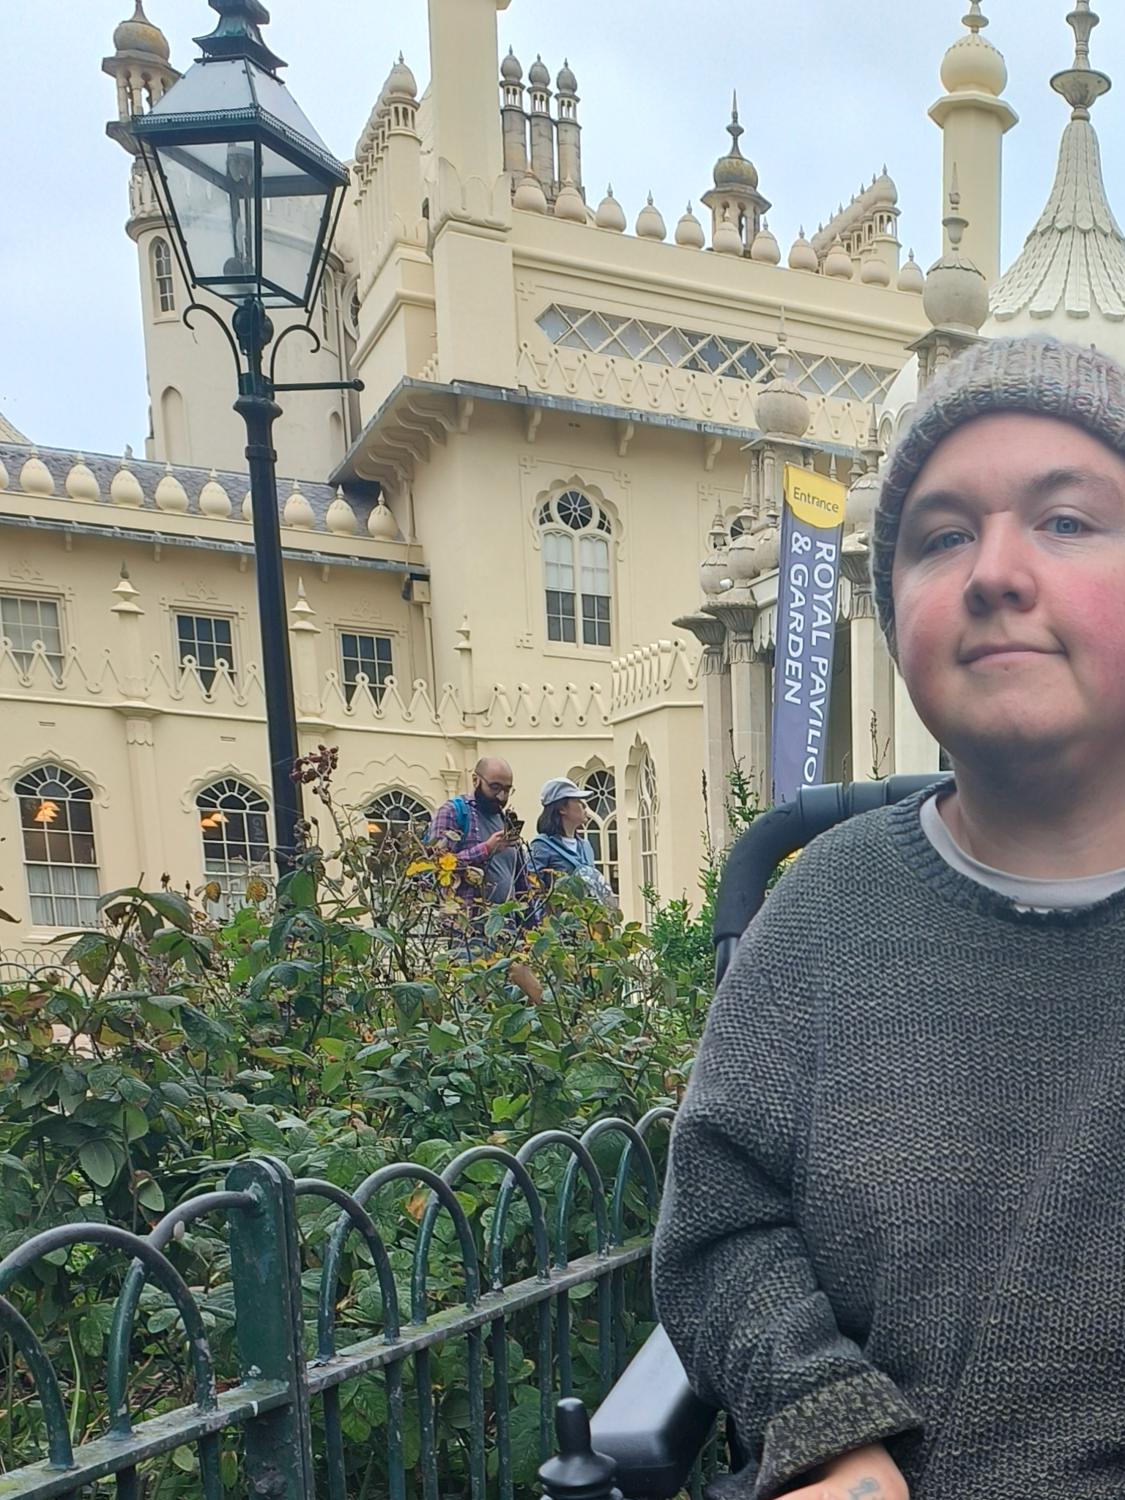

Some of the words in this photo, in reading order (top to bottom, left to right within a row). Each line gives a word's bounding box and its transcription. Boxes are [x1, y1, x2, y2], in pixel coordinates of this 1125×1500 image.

[791, 531, 811, 555] &
[793, 486, 839, 513] Entrance
[784, 563, 809, 705] GARDEN
[811, 541, 836, 646] ROYAL
[802, 655, 829, 788] PAVILIO
